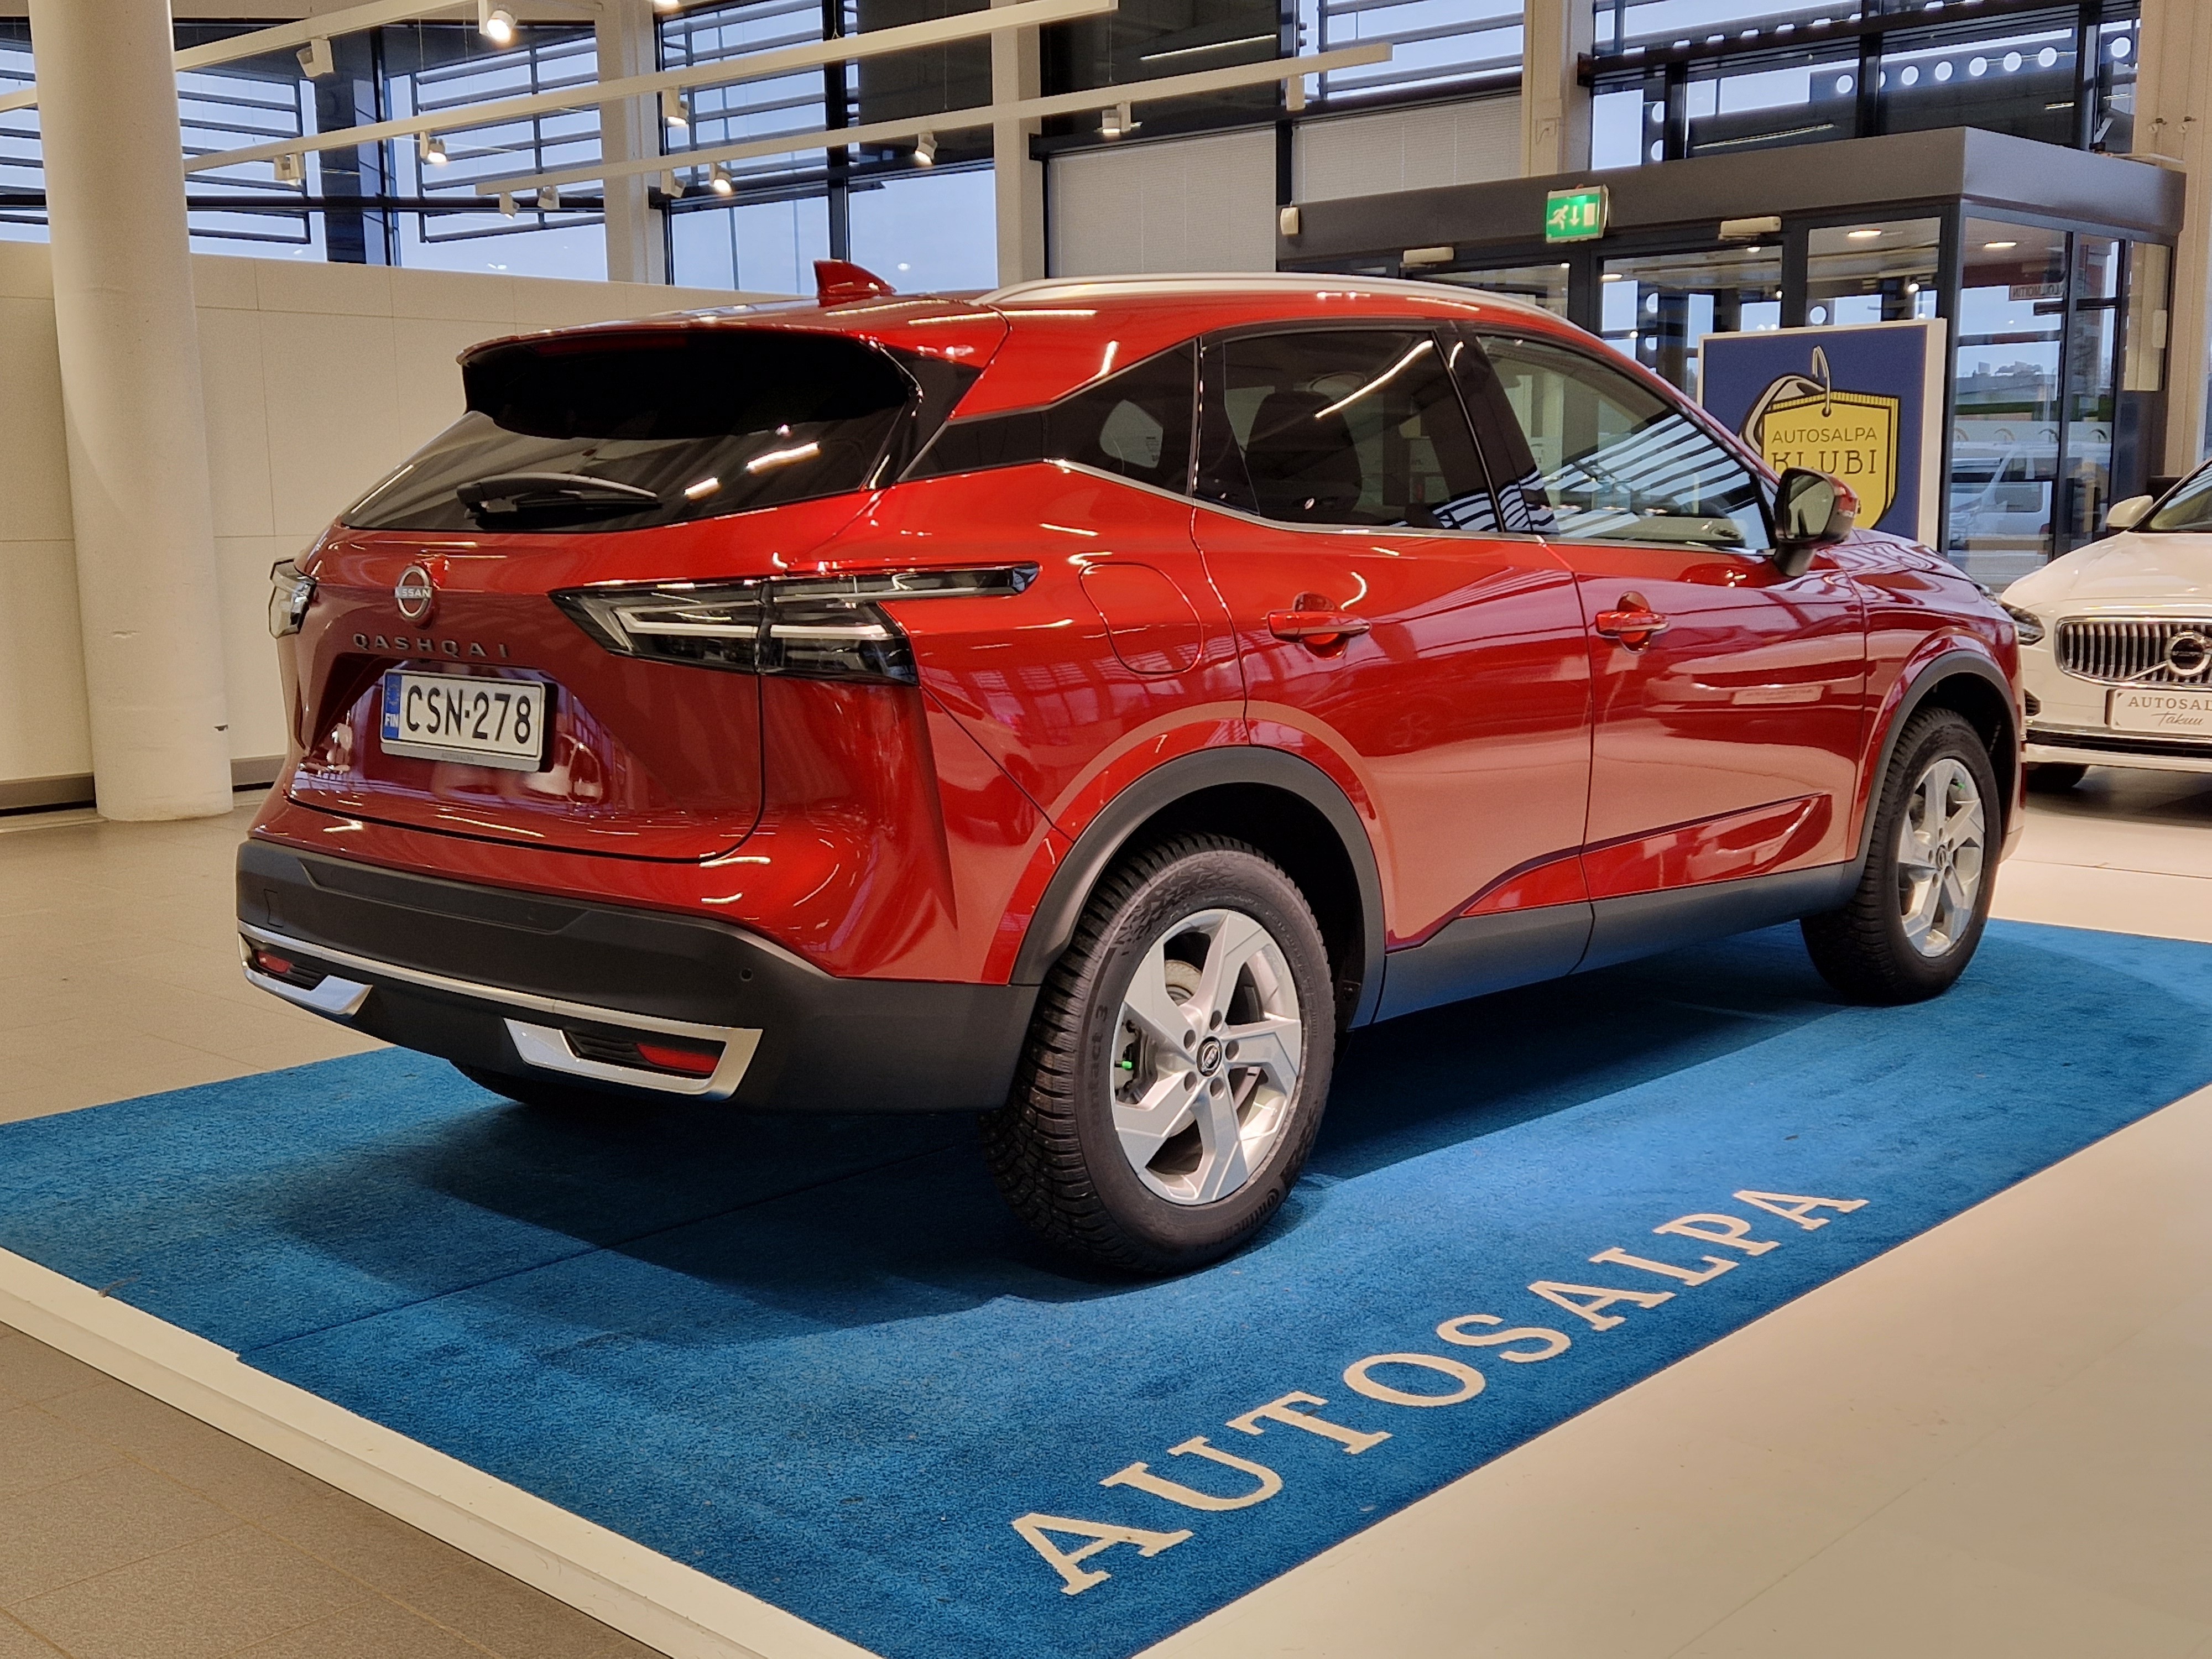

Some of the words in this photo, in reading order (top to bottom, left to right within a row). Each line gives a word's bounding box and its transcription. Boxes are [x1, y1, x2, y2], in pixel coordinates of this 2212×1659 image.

[1772, 427, 1877, 444] AUTOSALPA
[1771, 449, 1877, 474] KLUBI
[395, 587, 431, 598] SSAN
[353, 633, 508, 658] QASHQAI
[384, 713, 398, 727] FIN
[406, 685, 531, 744] CSN-278
[1012, 1191, 1867, 1595] AUTOSALPA
